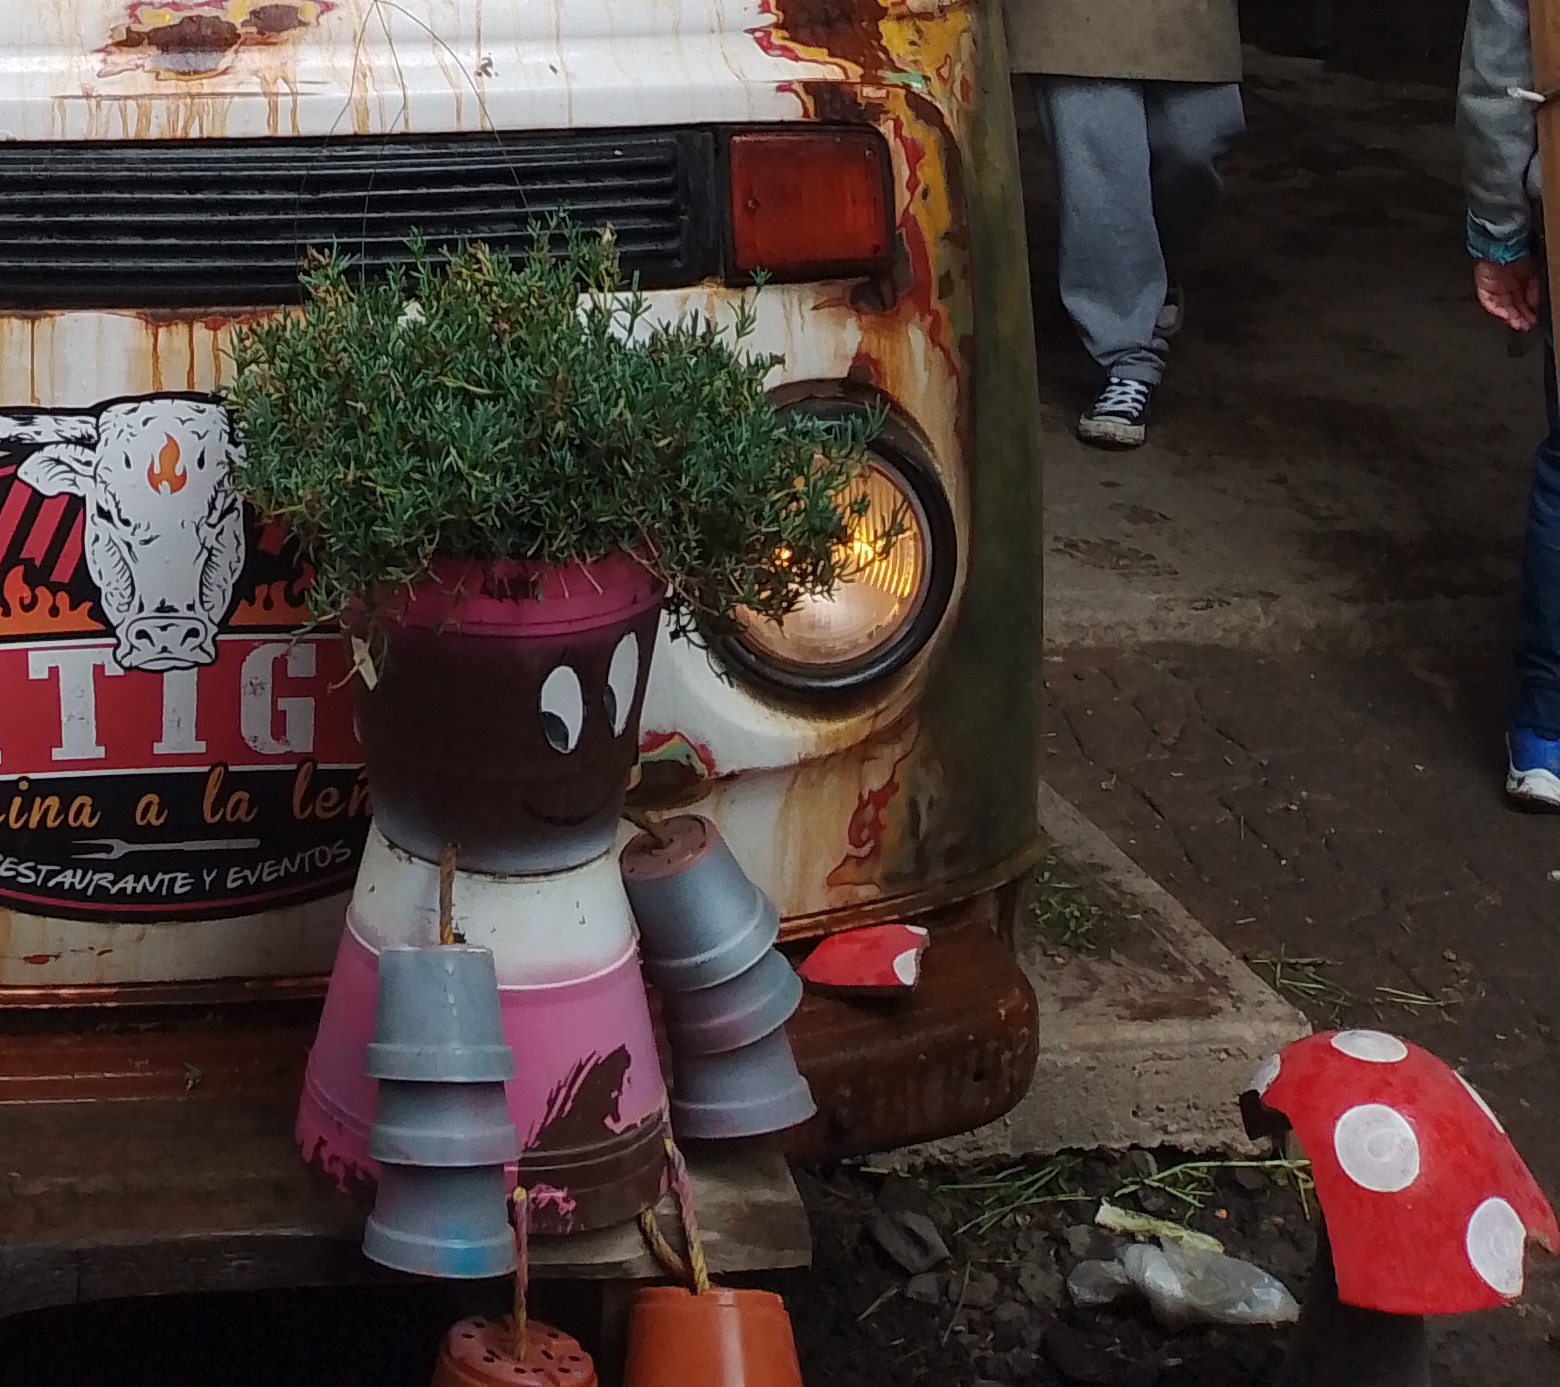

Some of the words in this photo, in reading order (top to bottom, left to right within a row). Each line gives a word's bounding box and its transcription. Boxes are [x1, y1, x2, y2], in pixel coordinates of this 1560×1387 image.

[135, 793, 168, 827] a
[203, 766, 259, 825] la
[292, 761, 374, 820] leñ
[203, 868, 220, 891] Y
[226, 839, 352, 889] EVENTOS
